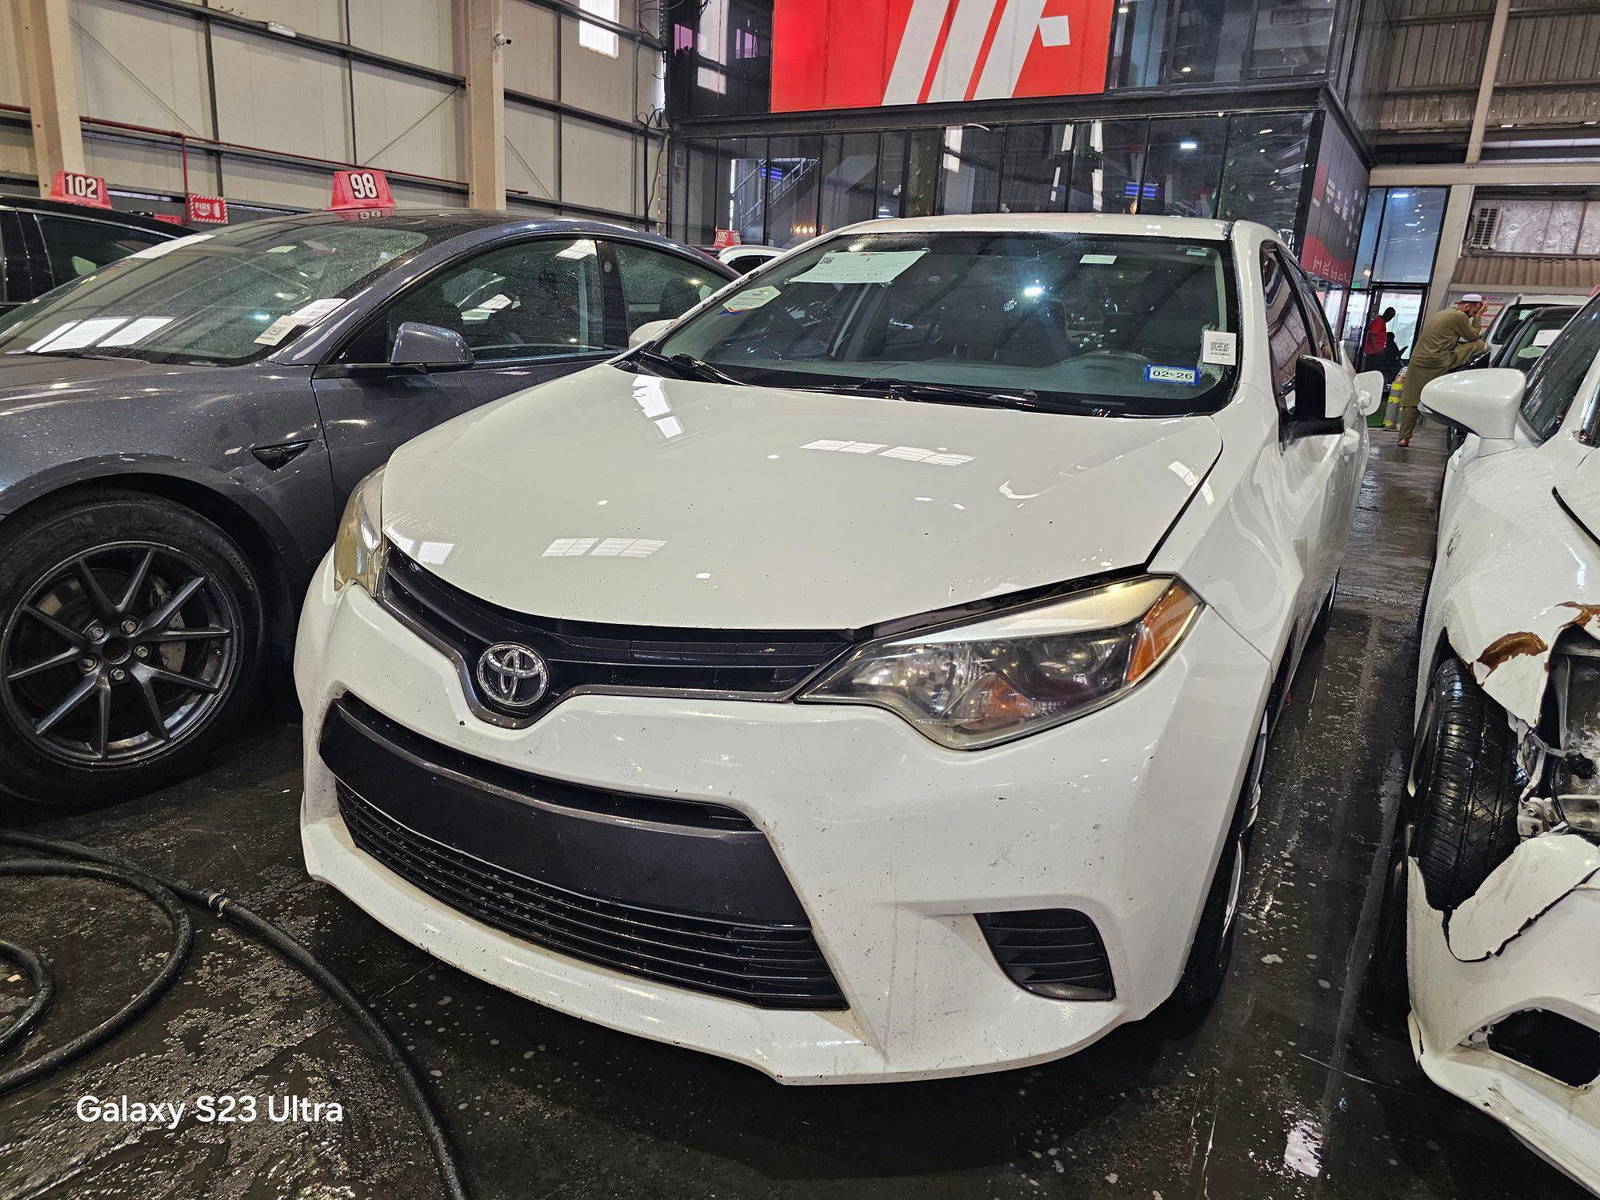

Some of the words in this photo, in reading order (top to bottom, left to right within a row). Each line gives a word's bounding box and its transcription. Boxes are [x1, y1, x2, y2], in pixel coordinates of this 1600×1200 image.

[65, 174, 98, 199] 102
[350, 173, 378, 199] 98
[195, 202, 212, 211] FIRE
